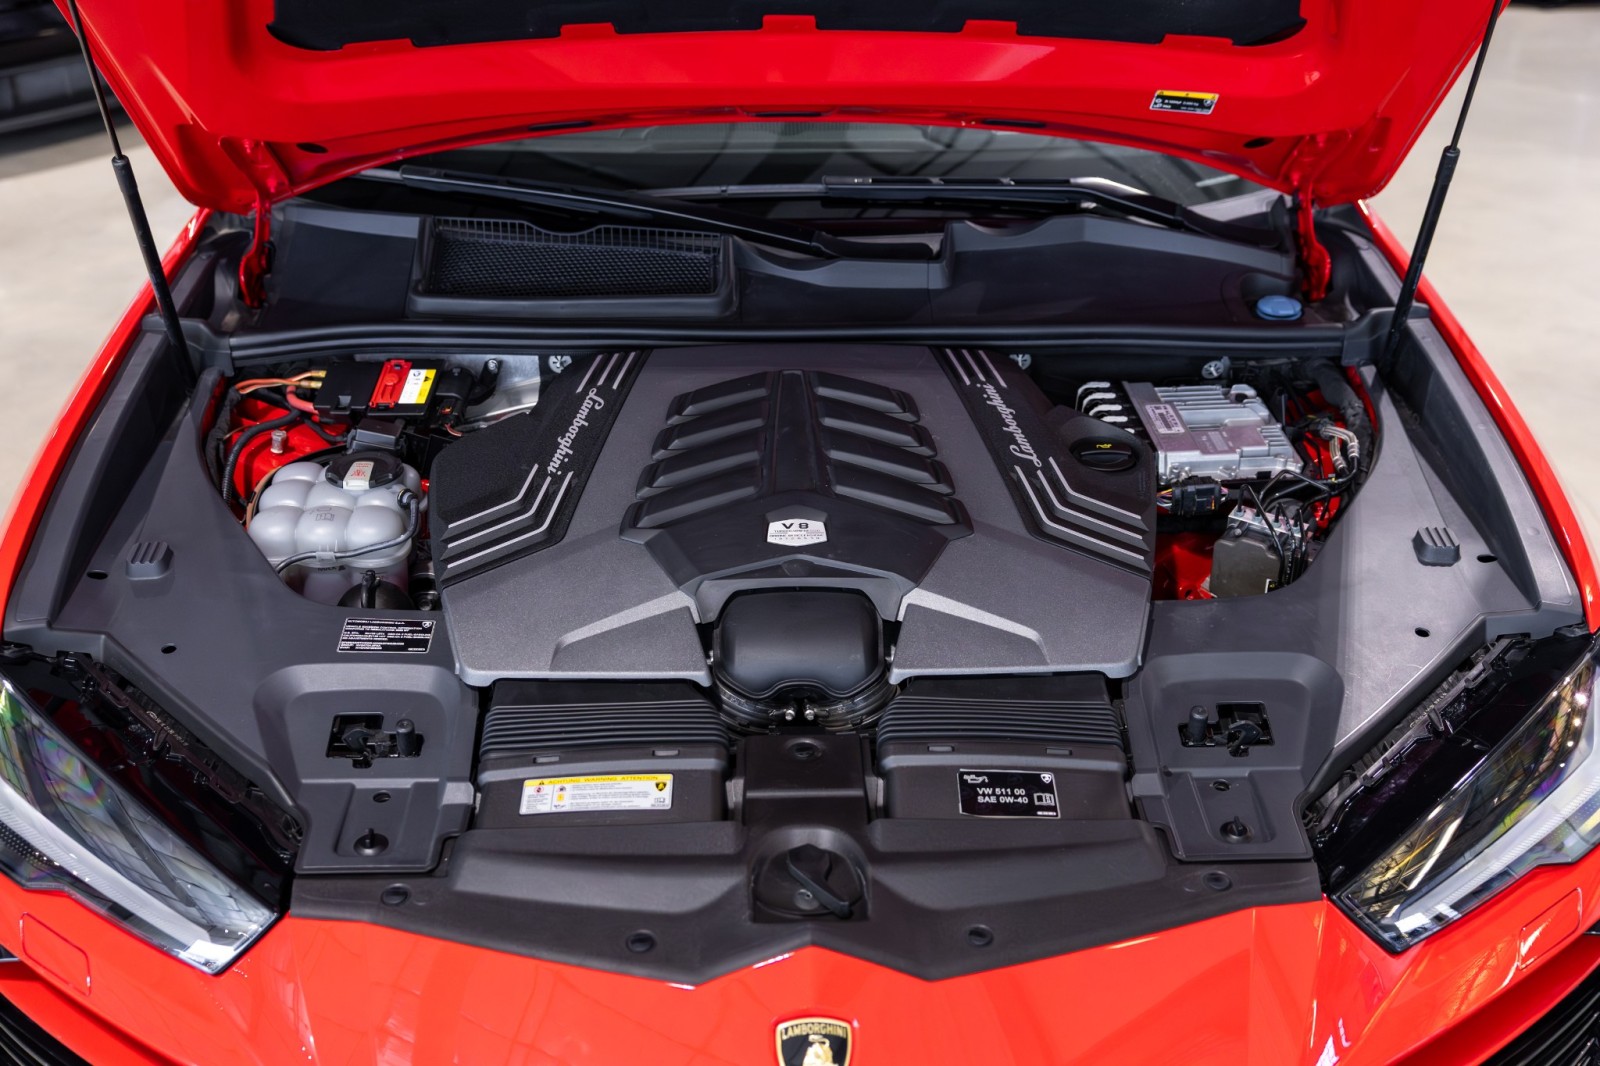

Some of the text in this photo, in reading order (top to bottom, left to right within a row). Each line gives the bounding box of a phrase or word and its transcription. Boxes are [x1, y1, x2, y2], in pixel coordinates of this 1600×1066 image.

[547, 387, 605, 475] Lamborghini
[976, 383, 1042, 468] Lamborghini
[976, 787, 1026, 796] VW 511 00
[977, 795, 997, 803] SAE
[781, 1022, 847, 1040] LAMBORGHINI
